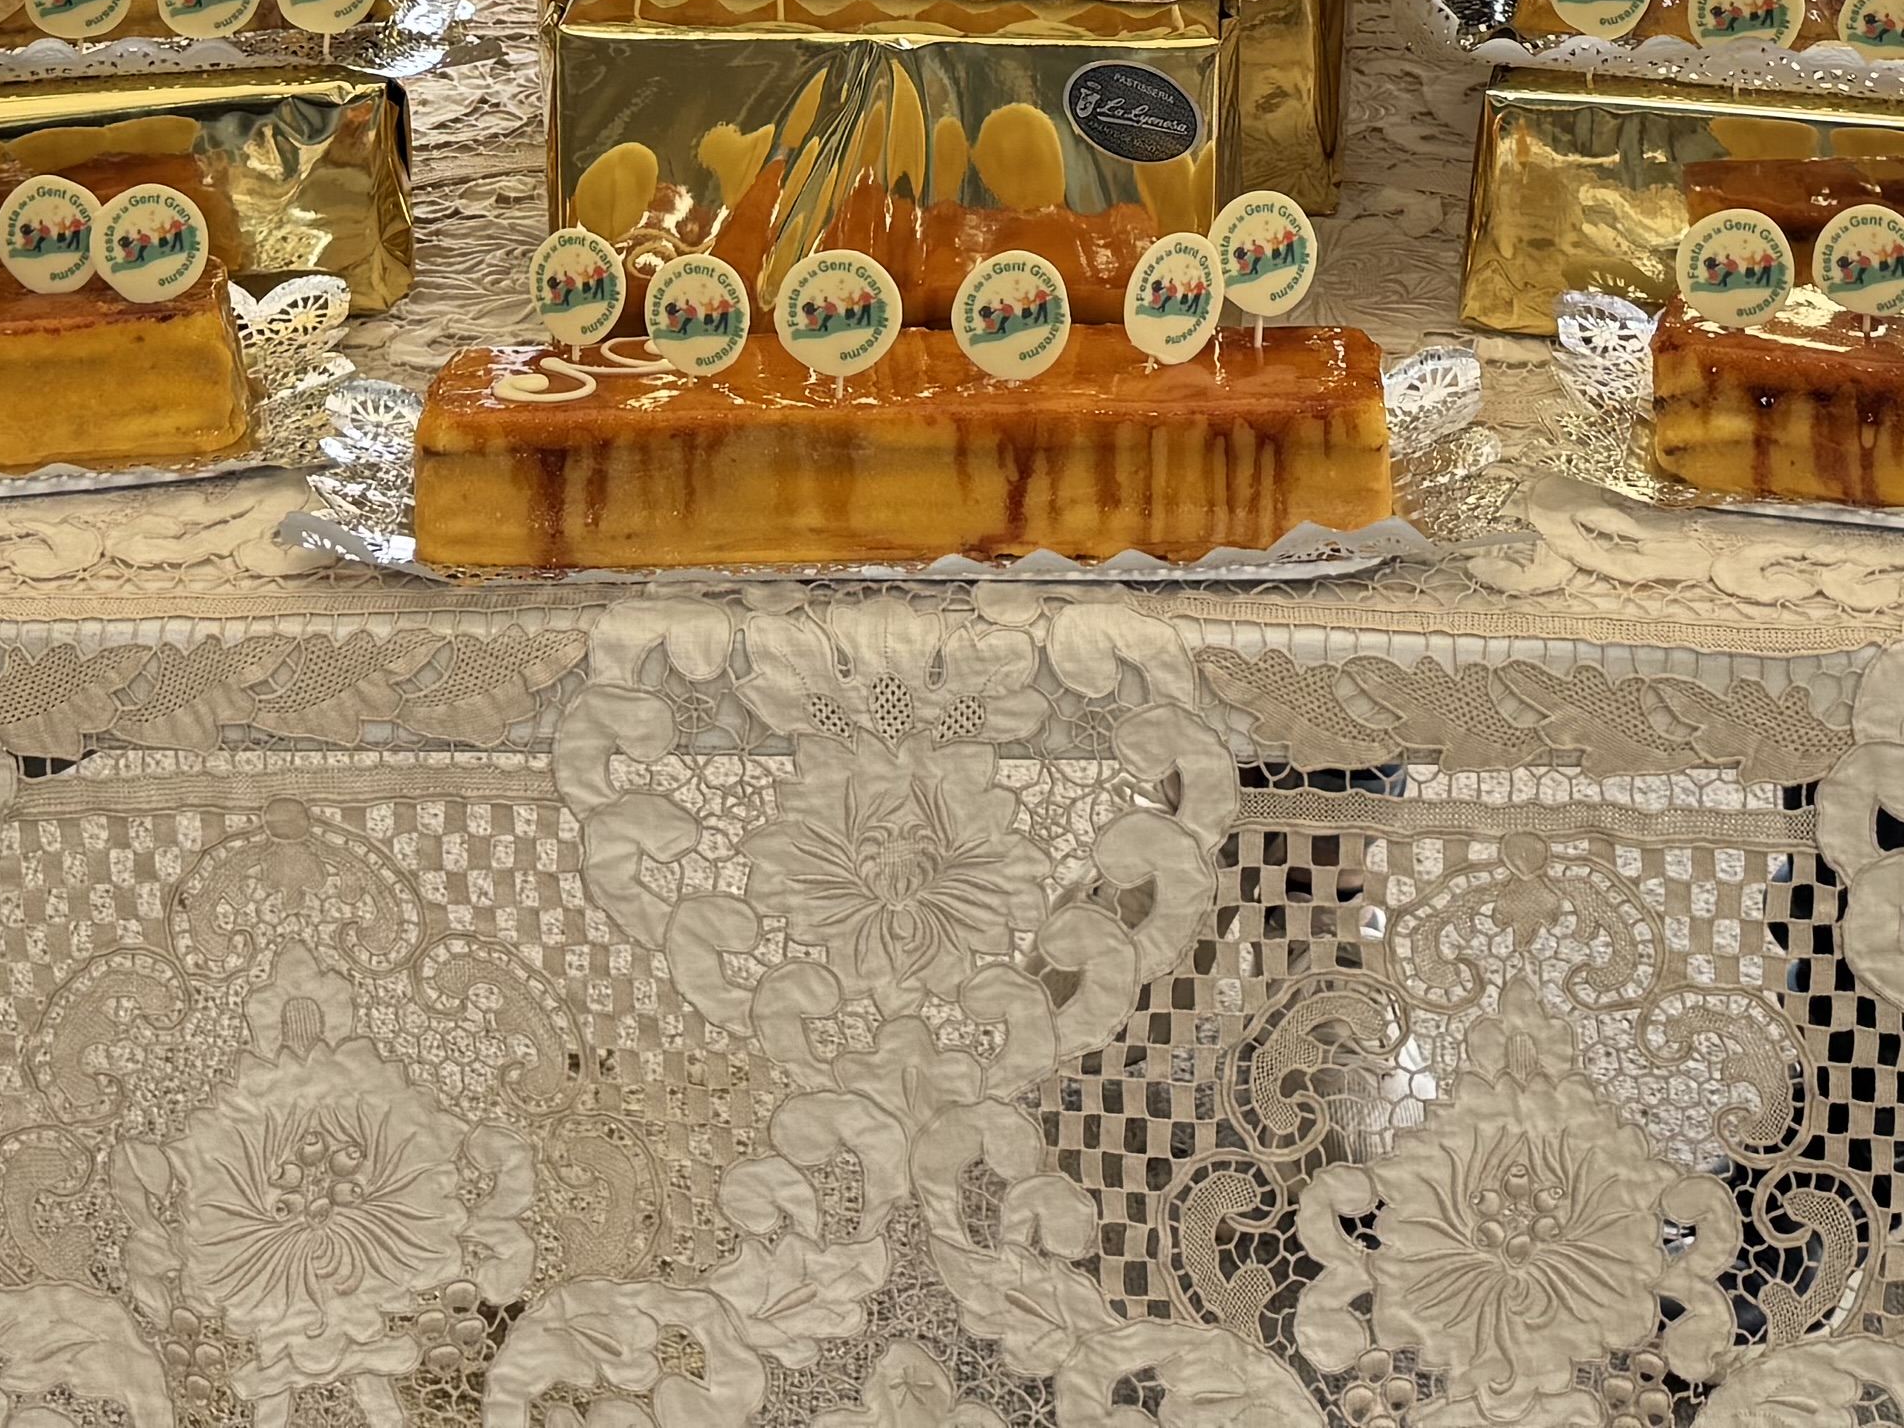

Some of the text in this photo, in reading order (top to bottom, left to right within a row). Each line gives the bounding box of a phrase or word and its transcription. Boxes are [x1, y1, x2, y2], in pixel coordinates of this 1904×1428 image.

[1113, 72, 1175, 105] PASTISSERIA
[1096, 97, 1189, 133] La Lyonesa
[128, 193, 161, 208] Gent
[164, 195, 192, 223] Gran
[1244, 201, 1275, 217] Gent
[1277, 204, 1303, 233] Gran
[103, 224, 117, 263] Festa
[557, 234, 586, 248] Gent
[1722, 218, 1758, 234] Gent
[1759, 228, 1784, 259] Gran
[158, 240, 201, 287] Maresme
[588, 239, 612, 270] Gran
[817, 260, 853, 274] Gent
[1173, 241, 1200, 260] Gent
[1220, 234, 1232, 276] Festa
[1687, 242, 1704, 280] Festa
[1822, 243, 1835, 283] Festa
[1848, 215, 1883, 229] Gent
[534, 262, 546, 303] Festa
[682, 262, 716, 279] Gent
[855, 265, 883, 296] Gran
[991, 260, 1027, 276] Gent
[1029, 263, 1058, 293] Gran
[1136, 264, 1155, 302] Festa
[1199, 254, 1213, 288] Gran
[1269, 252, 1311, 302] Maresme
[717, 272, 741, 305] Gran
[1735, 280, 1788, 318] Maresme
[580, 290, 620, 335] Maresme
[649, 287, 665, 327] Festa
[786, 288, 801, 328] Festa
[964, 292, 977, 334] Festa
[839, 317, 889, 362] Maresme
[1018, 313, 1066, 362] Maresme
[1164, 310, 1211, 347] Maresme
[695, 328, 745, 367] Maresme
